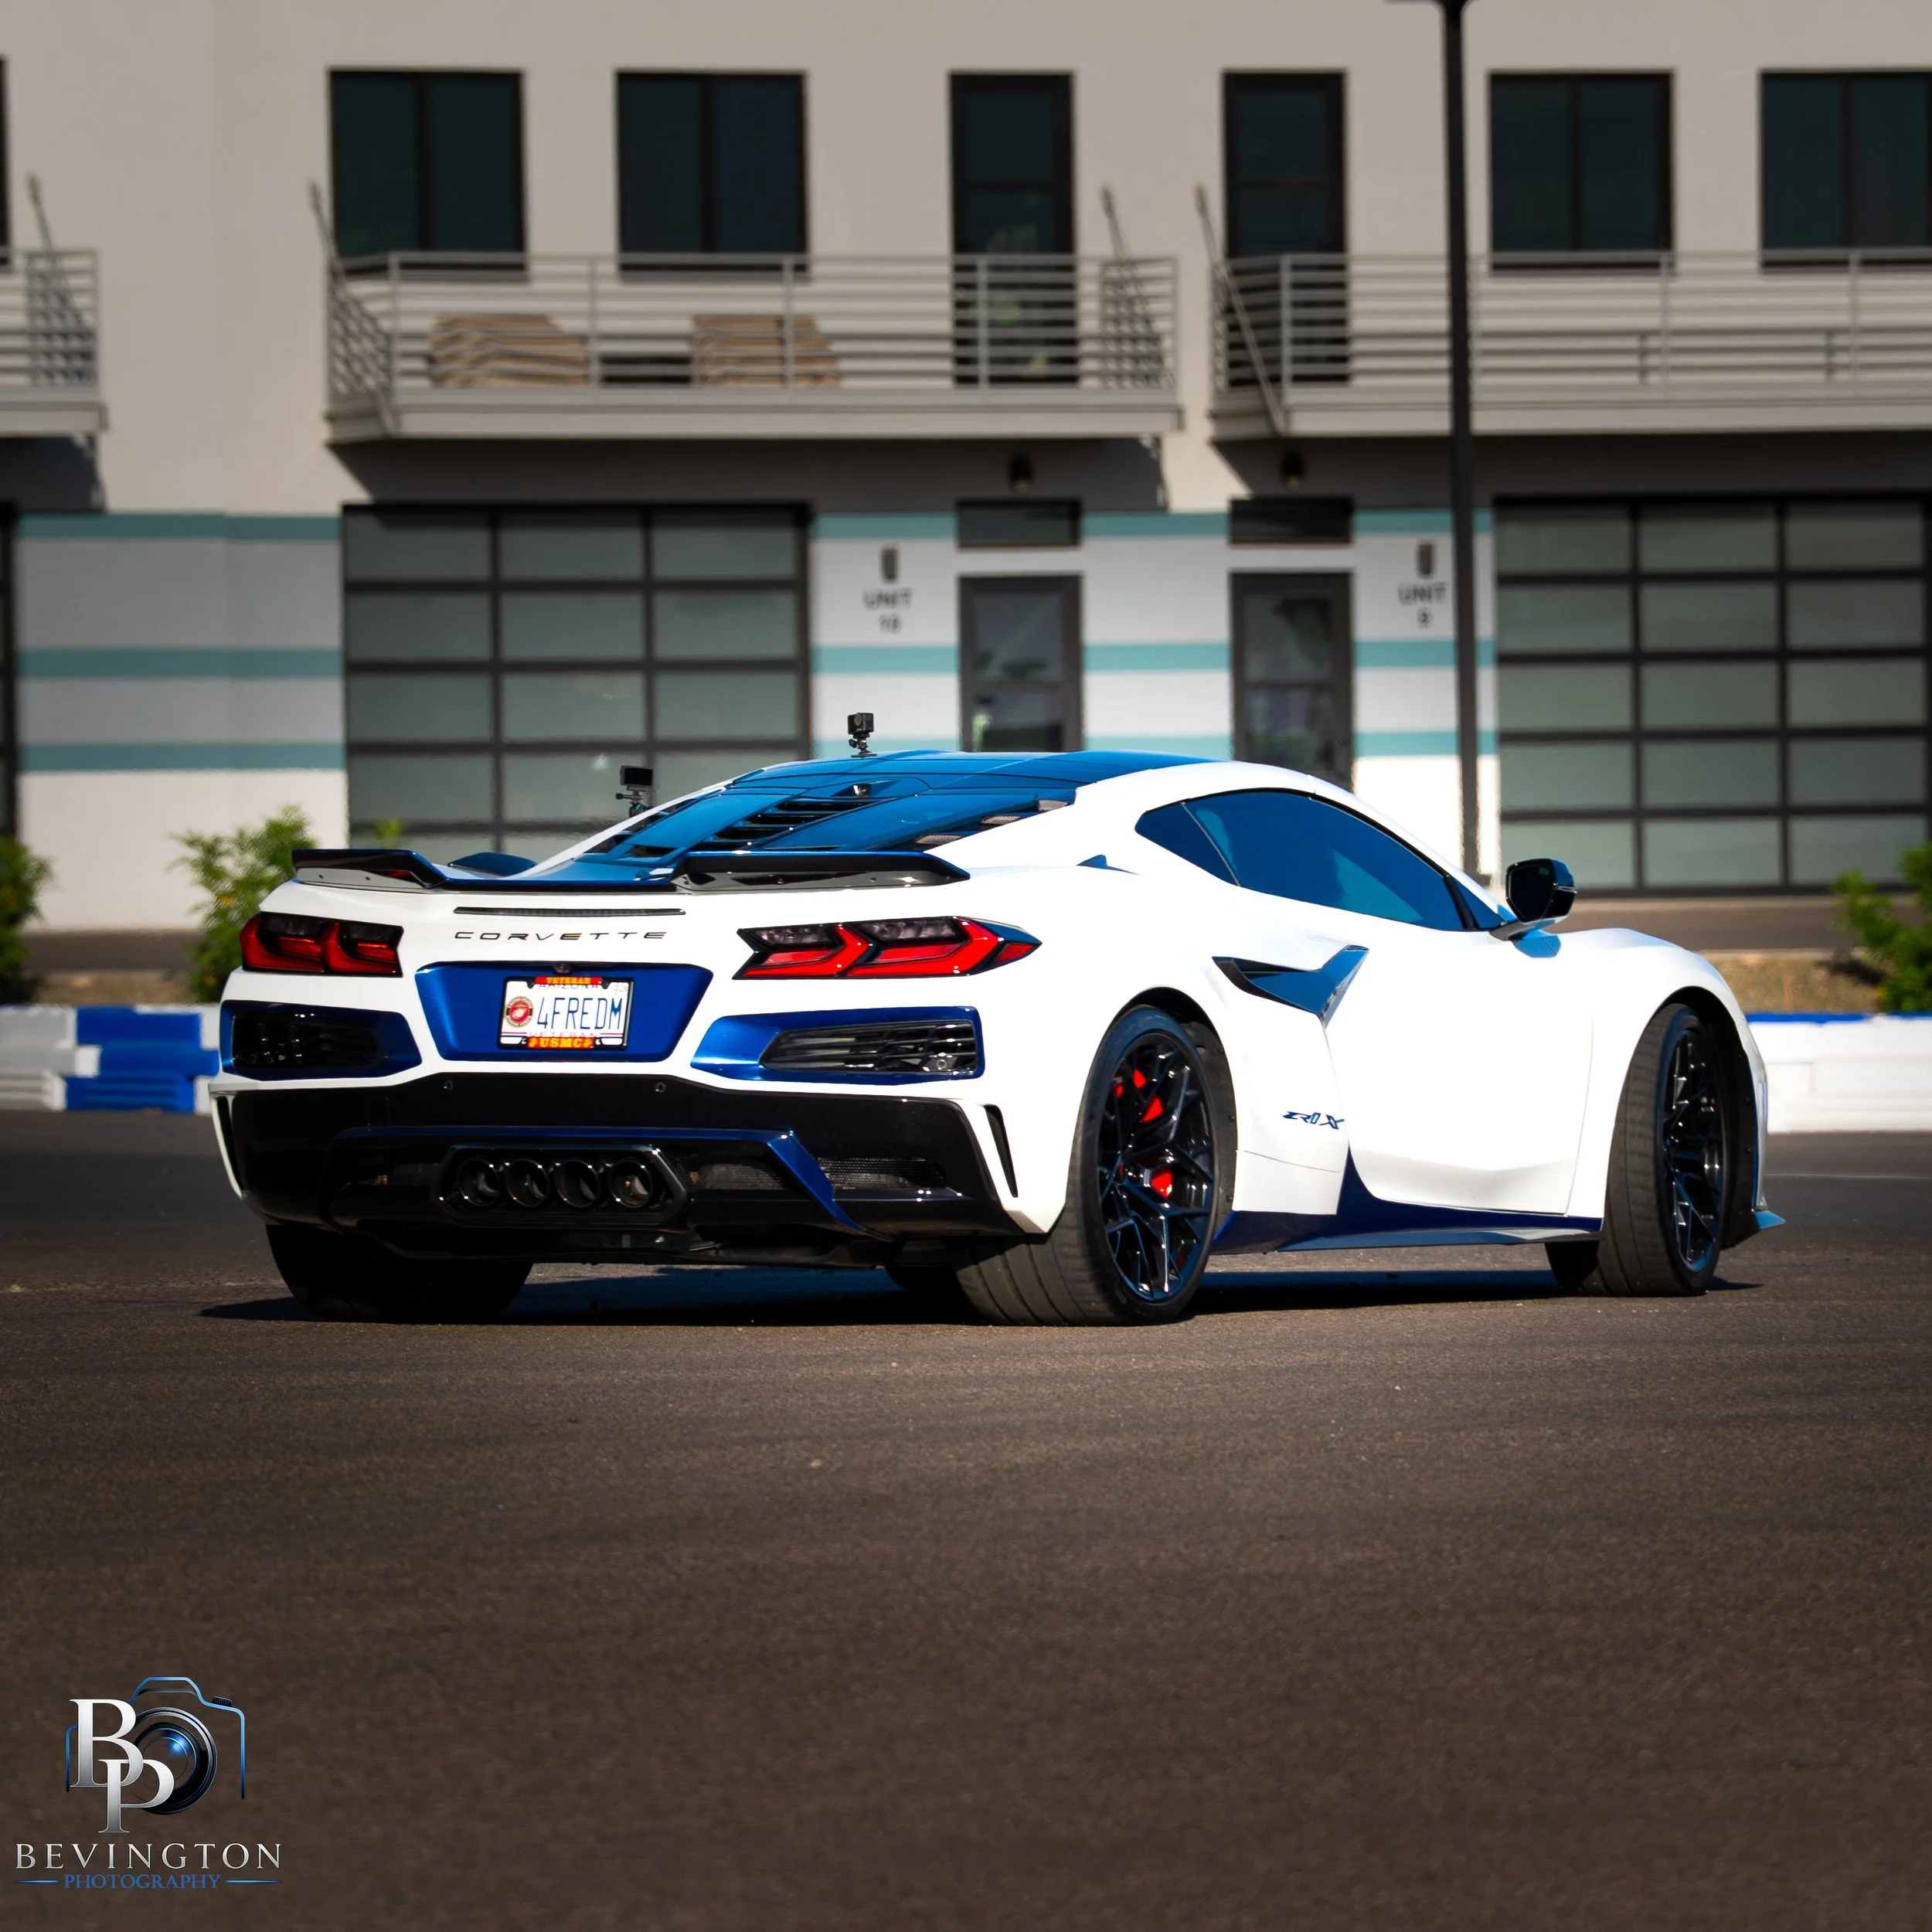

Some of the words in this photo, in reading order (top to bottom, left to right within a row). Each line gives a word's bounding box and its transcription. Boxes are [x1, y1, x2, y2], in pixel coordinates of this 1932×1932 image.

[862, 588, 913, 609] UNIT
[1398, 582, 1447, 605] UNIT
[454, 931, 668, 940] CORVETTE
[536, 997, 623, 1030] 4FREDM
[539, 1038, 583, 1048] USMC
